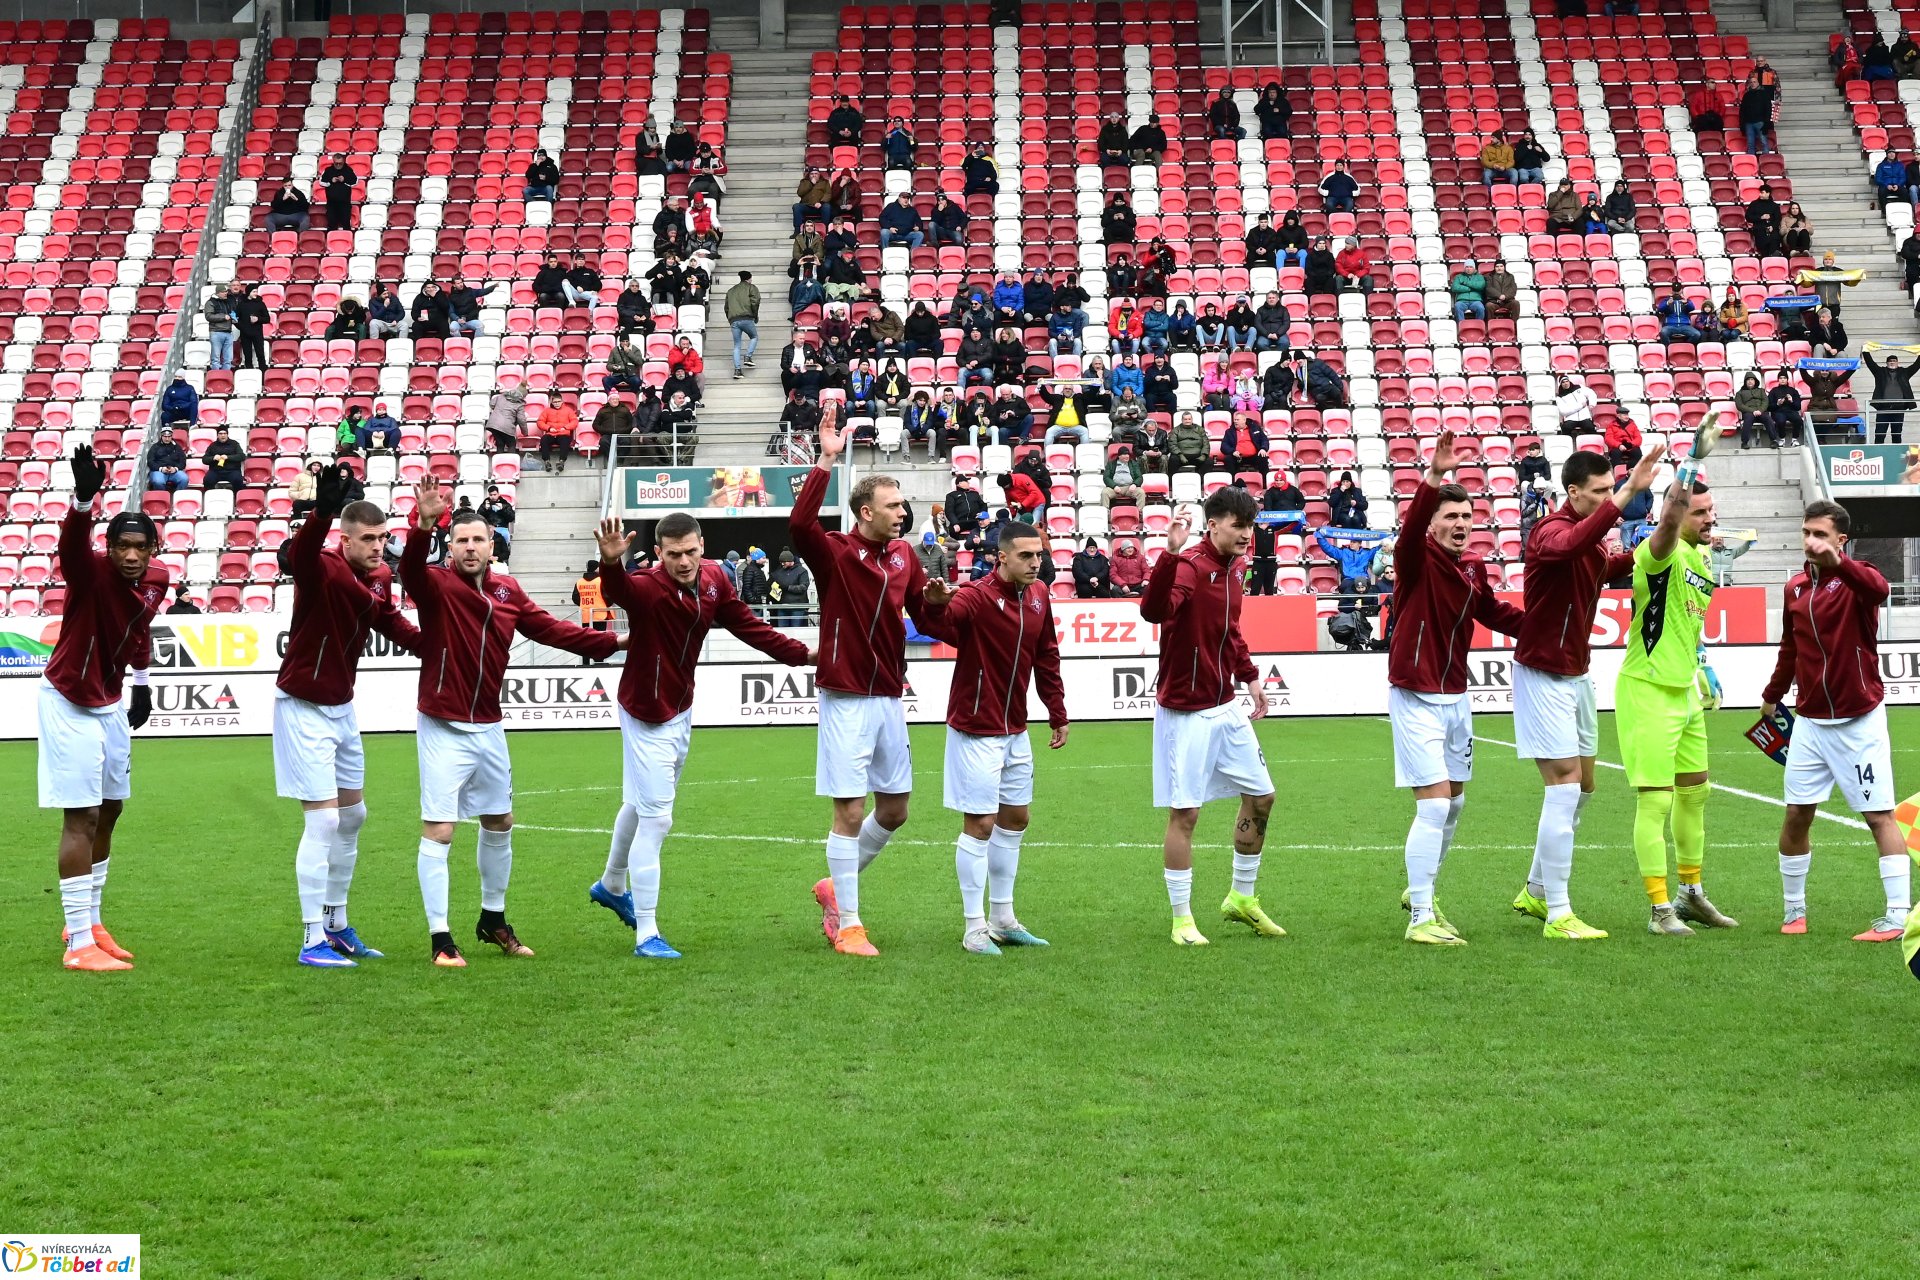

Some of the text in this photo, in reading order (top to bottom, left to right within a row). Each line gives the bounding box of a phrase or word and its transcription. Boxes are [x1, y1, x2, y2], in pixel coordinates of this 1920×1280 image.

[1834, 465, 1881, 476] BORSODI
[640, 488, 687, 499] BORSODI
[1072, 613, 1137, 643] fizz
[0, 654, 51, 666] kont-NE
[500, 676, 612, 704] RUKA
[522, 710, 544, 720] ÉS
[552, 709, 613, 720] TÁRSA
[741, 706, 818, 716] DARUKA
[150, 716, 240, 727] ÉS TÁRSA
[1751, 722, 1775, 749] NY
[1855, 763, 1875, 785] 14
